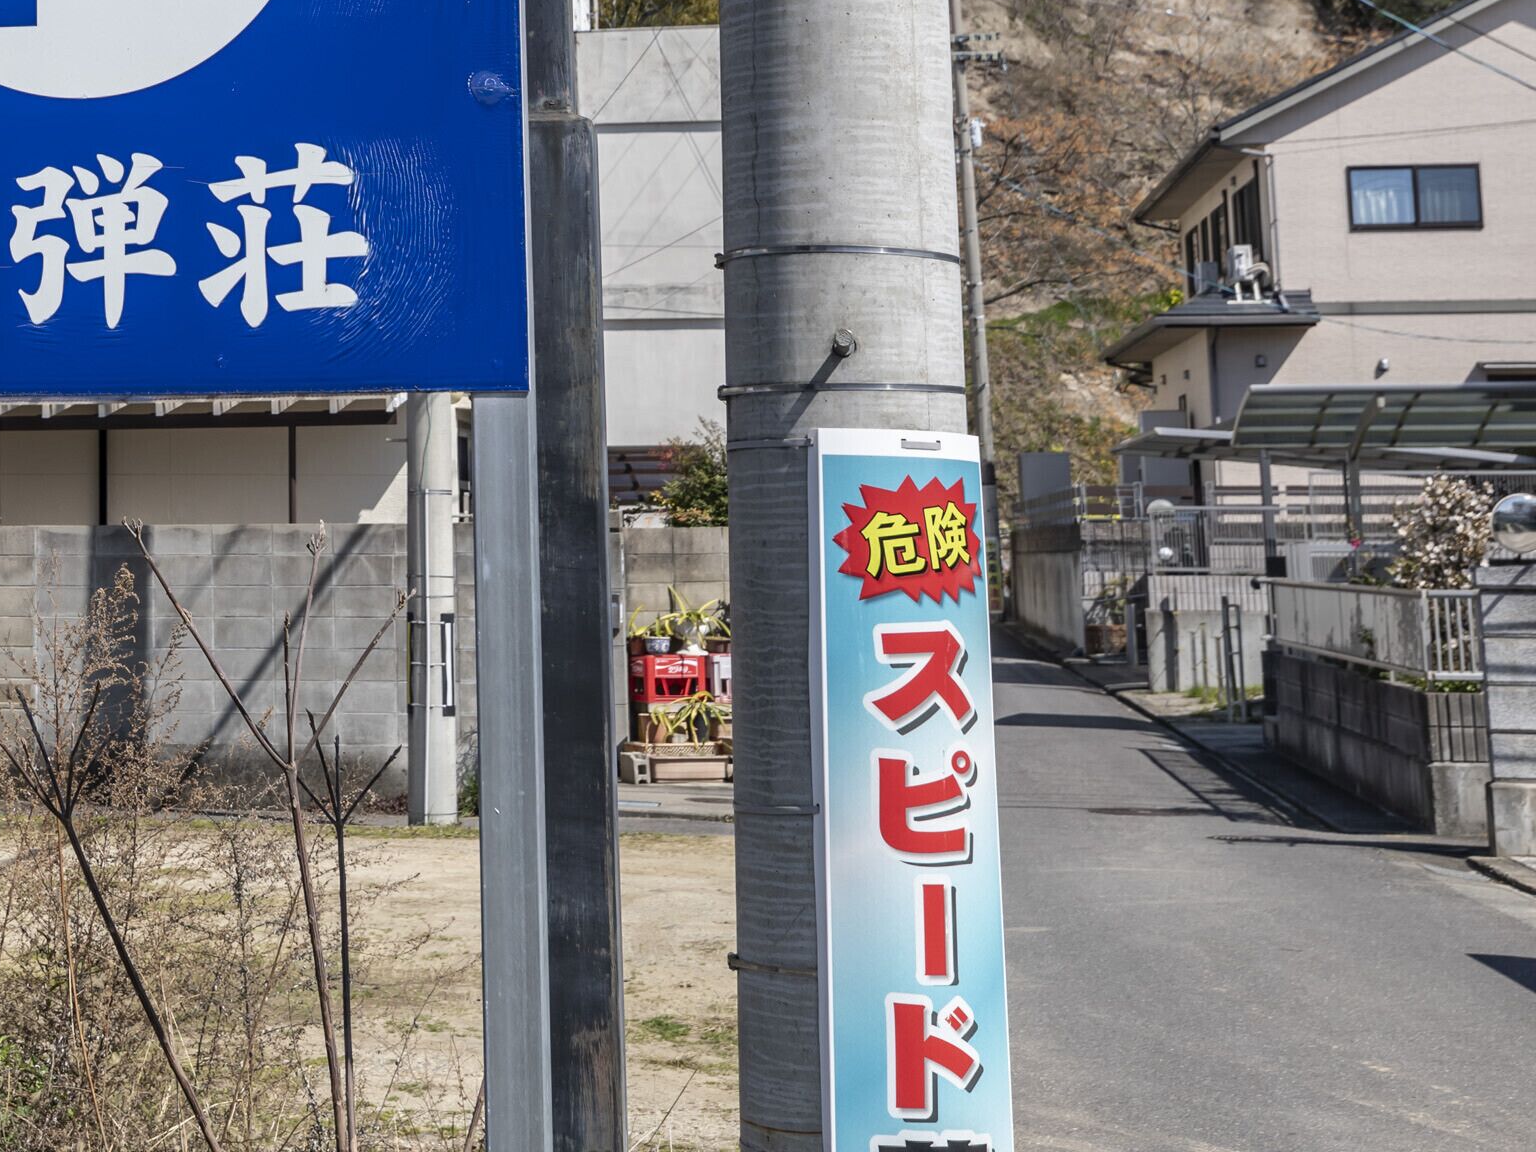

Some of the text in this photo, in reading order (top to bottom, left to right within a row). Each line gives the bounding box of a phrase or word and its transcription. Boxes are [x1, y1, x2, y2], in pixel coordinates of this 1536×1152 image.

[859, 501, 971, 578] 危険
[868, 627, 990, 1152] スピード
